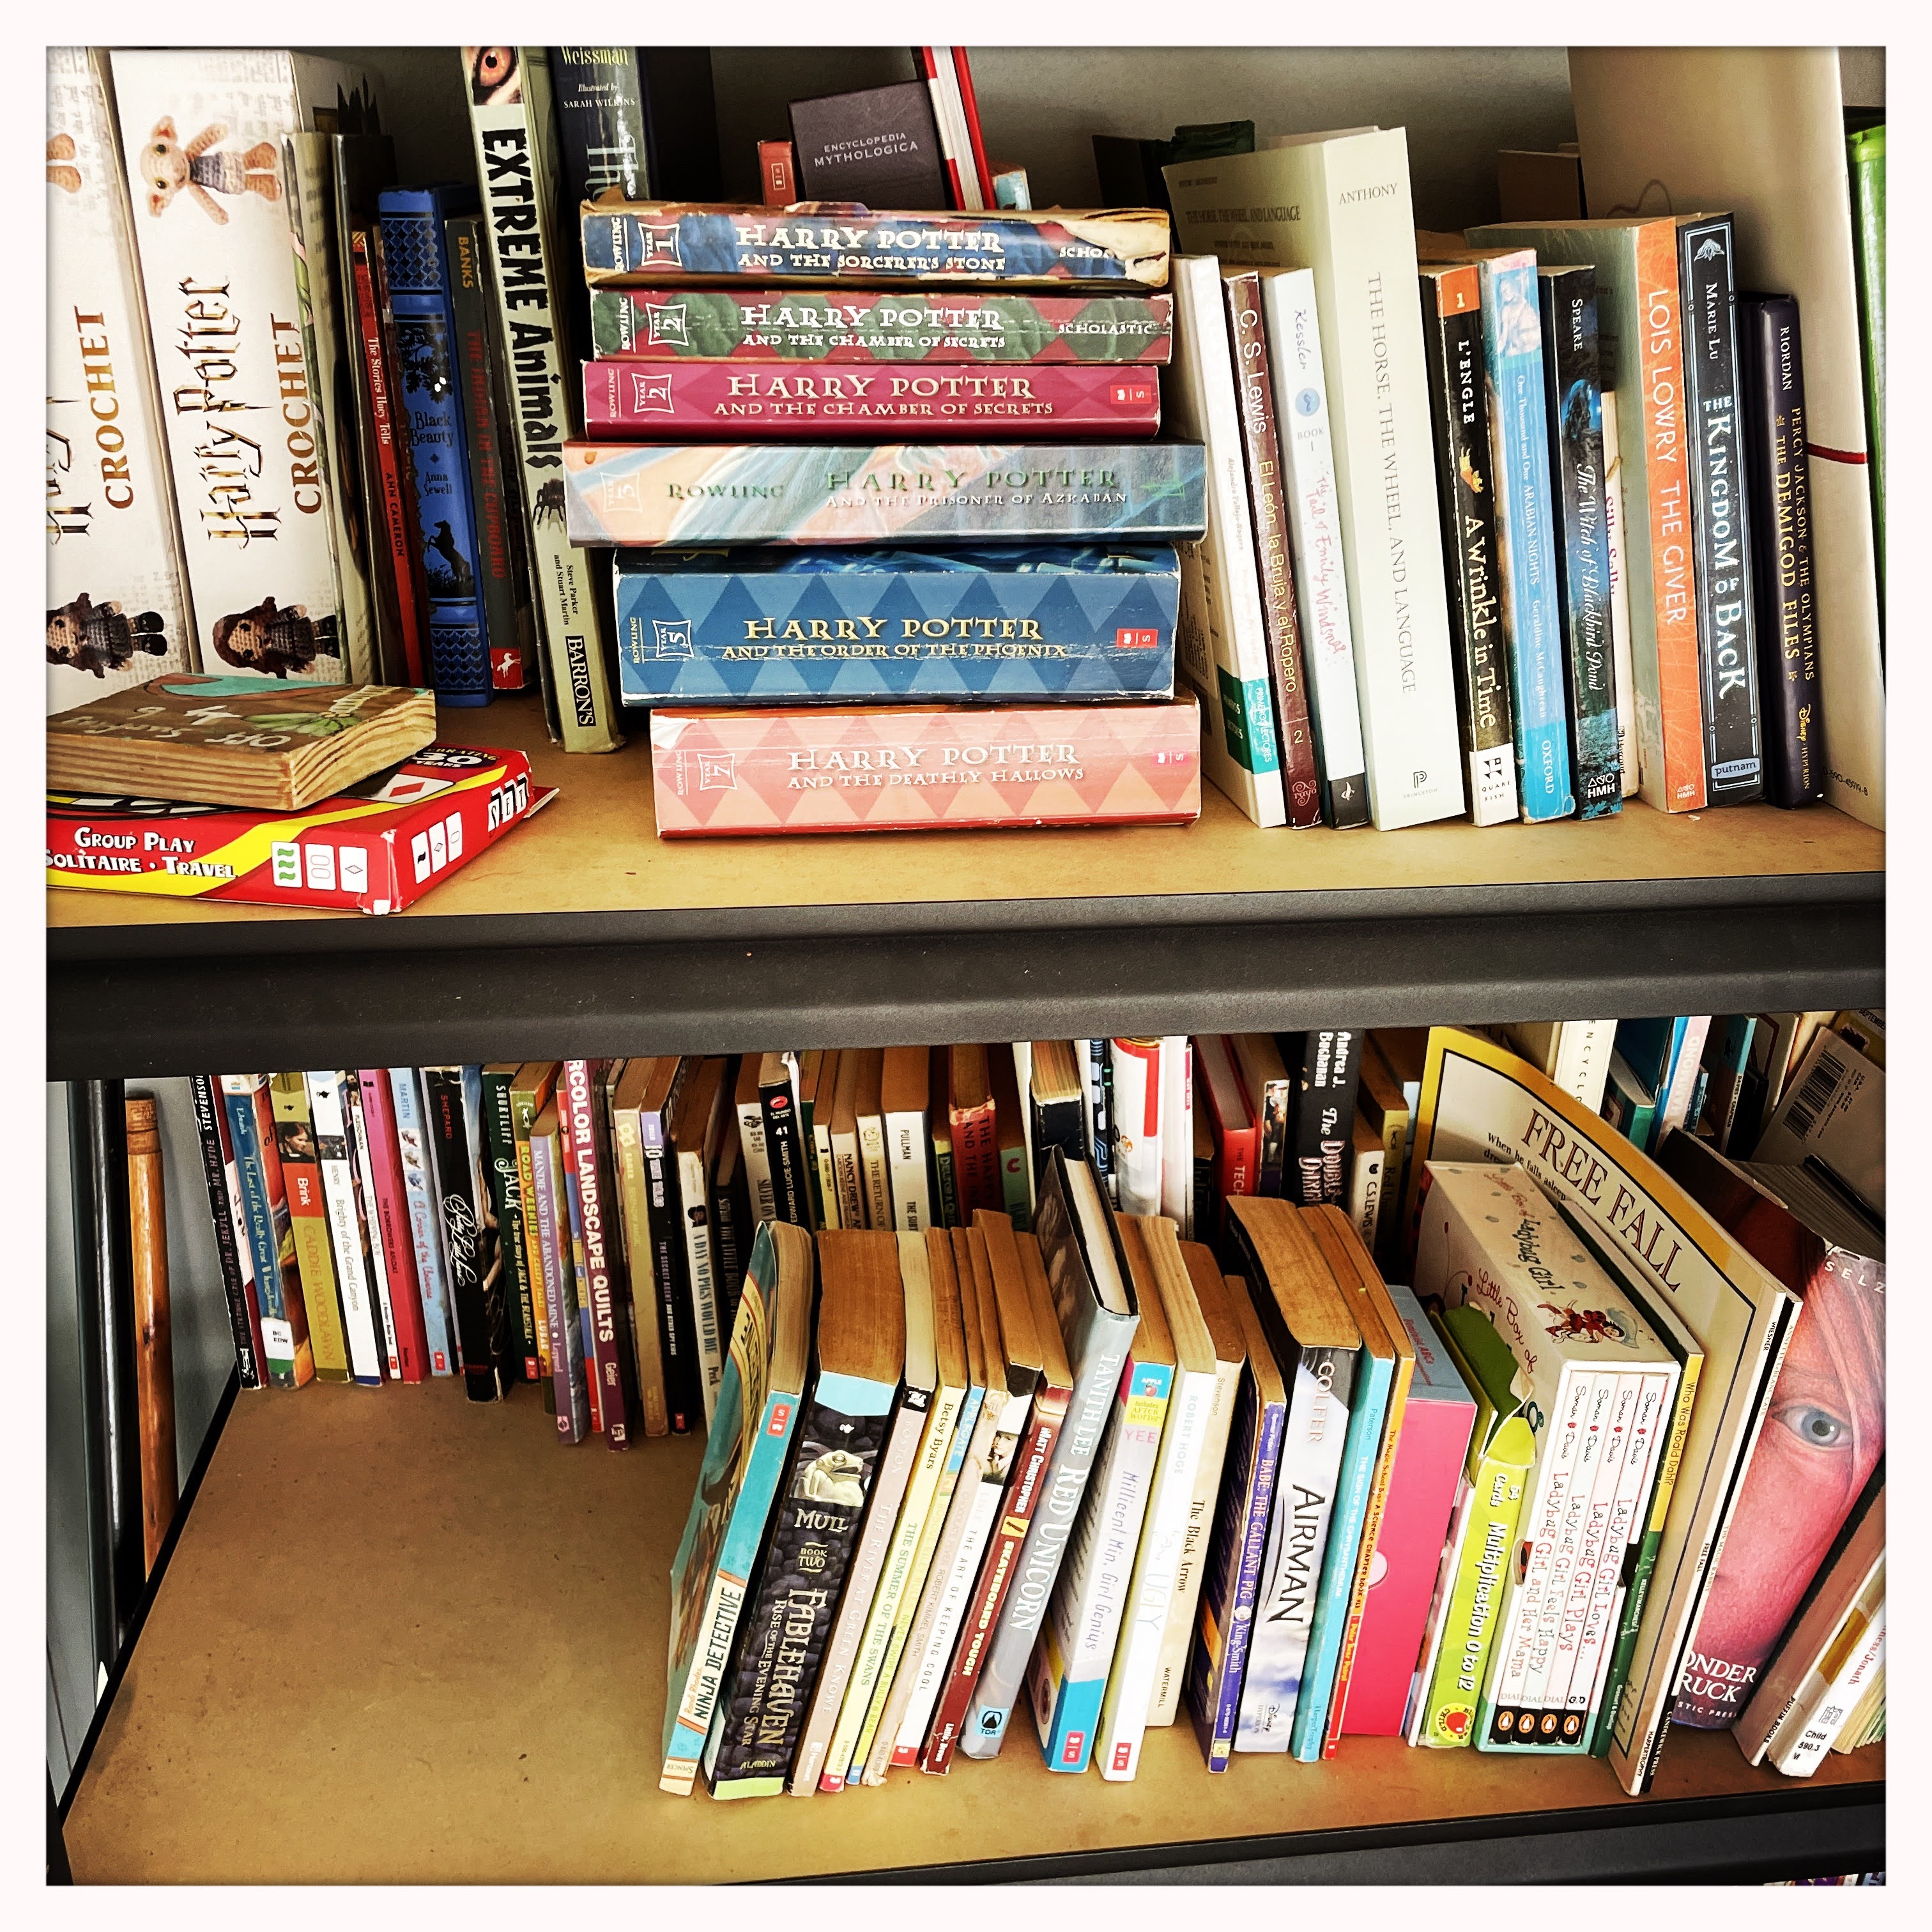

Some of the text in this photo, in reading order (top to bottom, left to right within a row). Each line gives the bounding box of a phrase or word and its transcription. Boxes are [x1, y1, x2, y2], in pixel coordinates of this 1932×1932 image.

[561, 47, 629, 66] Weissman
[564, 98, 636, 108] SARAH WILKINS
[813, 141, 918, 167] MYTHOLOGICA
[824, 132, 907, 153] ENCYCLOPEDIA
[1339, 183, 1398, 205] ANTHONY
[458, 236, 474, 288] BANKS
[735, 225, 1005, 253] HARRY POTTER
[737, 254, 1005, 270] AND THE SORCERER'S STONE
[482, 128, 563, 469] EXTREME Animals
[741, 305, 1005, 331] HARRY POTTER
[1572, 298, 1583, 351] SPEARE
[1705, 282, 1719, 360] MARIE LU
[742, 334, 1005, 349] AND THE CHAMBER OF SECRETS
[1058, 323, 1152, 335] SCHOLASTIC
[1239, 309, 1270, 434] C. S. Lewis
[1458, 339, 1475, 425] L'ENGLE
[1779, 325, 1793, 392] RIORDAN
[74, 305, 134, 509] CROCHET
[173, 276, 281, 550] Harry Potter
[270, 312, 322, 514] CROCHET
[367, 337, 390, 445] The Stories Huey Tells
[714, 402, 1053, 415] AND THE CHAMBER OF SECRETS
[726, 374, 1036, 399] HARRY POTTER
[666, 469, 1117, 499] ROWLING HARRY POTTER
[1648, 289, 1686, 625] LOIS LOWRY THE GIVER
[826, 493, 1128, 507] AND THE PRISONER OF AZKABAN
[1703, 395, 1745, 700] THE KINGDOM OF BACK
[1775, 473, 1800, 660] DEMIGOD FILES
[556, 569, 566, 596] Stuart
[566, 565, 579, 615] Steve Parker
[1259, 459, 1297, 693] El León, la Bruja y el Ropero
[560, 598, 570, 625] Martin
[743, 616, 1043, 640] HARRY POTTER
[1464, 516, 1503, 729] A Wrinkle in Time
[723, 643, 1069, 658] AND THE ORDER OF THE PHOENIX
[567, 638, 594, 726] BARRON'S
[787, 743, 1081, 772] HARRY POTTER
[787, 767, 1084, 790] AND THE DEATHLY HALLOWS
[1540, 739, 1554, 795] OXFORD
[1714, 761, 1757, 777] putnam
[47, 849, 236, 879] SOLITAIRE TRAVEL
[74, 827, 195, 854] GROUP PLAY
[1314, 1032, 1334, 1087] Buchanan
[1331, 1031, 1352, 1089] Andrea J.
[776, 1126, 788, 1136] 41
[900, 1128, 912, 1162] PULLMAN
[296, 1177, 310, 1206] Brink
[780, 1140, 798, 1223] EDWARD LUCIE-SMITH
[1486, 1131, 1567, 1202] When he falls asleep
[1521, 1108, 1682, 1293] FREE FALL
[578, 1147, 615, 1344] LANDSCAPE QUILTS
[1081, 1354, 1121, 1422] TANITH
[1307, 1360, 1333, 1445] COLFER
[926, 1402, 954, 1472] Betsy Byars
[1070, 1425, 1096, 1457] LEE
[1125, 1428, 1158, 1444] YEE
[1662, 1381, 1698, 1486] Who Was Roald Dahl?
[1013, 1427, 1052, 1514] MATT CHRISTOPHER
[1047, 1465, 1091, 1521] RED
[794, 1508, 849, 1533] MULL
[1177, 1499, 1206, 1594] The Black Arrow
[1239, 1457, 1275, 1601] BABE: THE GALLANT PIG
[1603, 1499, 1633, 1567] Ladybug
[797, 1556, 825, 1568] TWO
[801, 1547, 827, 1558] BOOK
[1009, 1522, 1069, 1632] UNICORN
[1085, 1470, 1138, 1651] Millicent Min, Girl Genius
[1265, 1482, 1328, 1624] AIRMAN
[1558, 1502, 1609, 1652] Ladybug Girl Plays
[860, 1522, 917, 1686] THE SUMMER OF THE SWANS
[962, 1540, 1015, 1676] SKATEBOARD TOUGH
[1457, 1521, 1507, 1692] Multiplication 0 to 12
[1596, 1568, 1614, 1601] Girl
[695, 1586, 742, 1721] NINJA DETECTIVE
[756, 1587, 827, 1746] FABLEHAVEN
[1158, 1666, 1171, 1708] WATERMILL
[1763, 1696, 1796, 1744] PUFFIN BOOKS
[1798, 1742, 1821, 1752] 590.3
[1805, 1729, 1827, 1740] Child
[739, 1757, 776, 1771] ALADDIN
